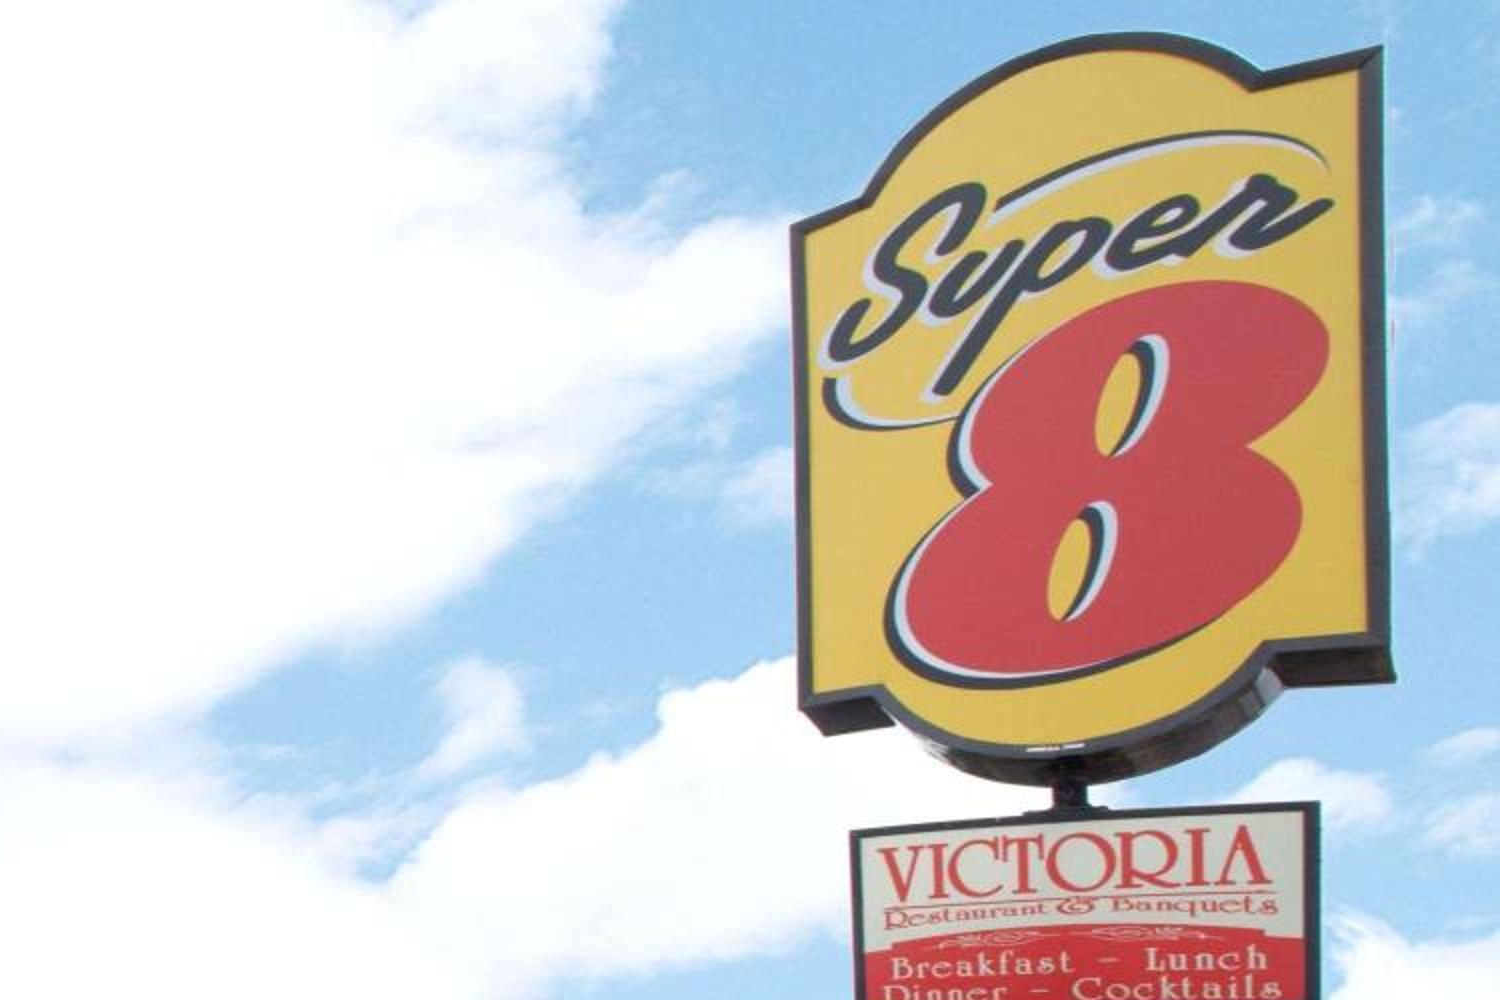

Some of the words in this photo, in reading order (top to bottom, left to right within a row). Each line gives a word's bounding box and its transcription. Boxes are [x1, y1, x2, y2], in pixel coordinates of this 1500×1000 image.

[825, 173, 1335, 398] Super
[883, 279, 1331, 691] 8
[877, 824, 1273, 903] VICTORIA
[884, 902, 1048, 931] Restaurant
[1111, 895, 1279, 918] Banquets
[891, 947, 1075, 981] Breakfast
[1145, 943, 1268, 972] Lunch
